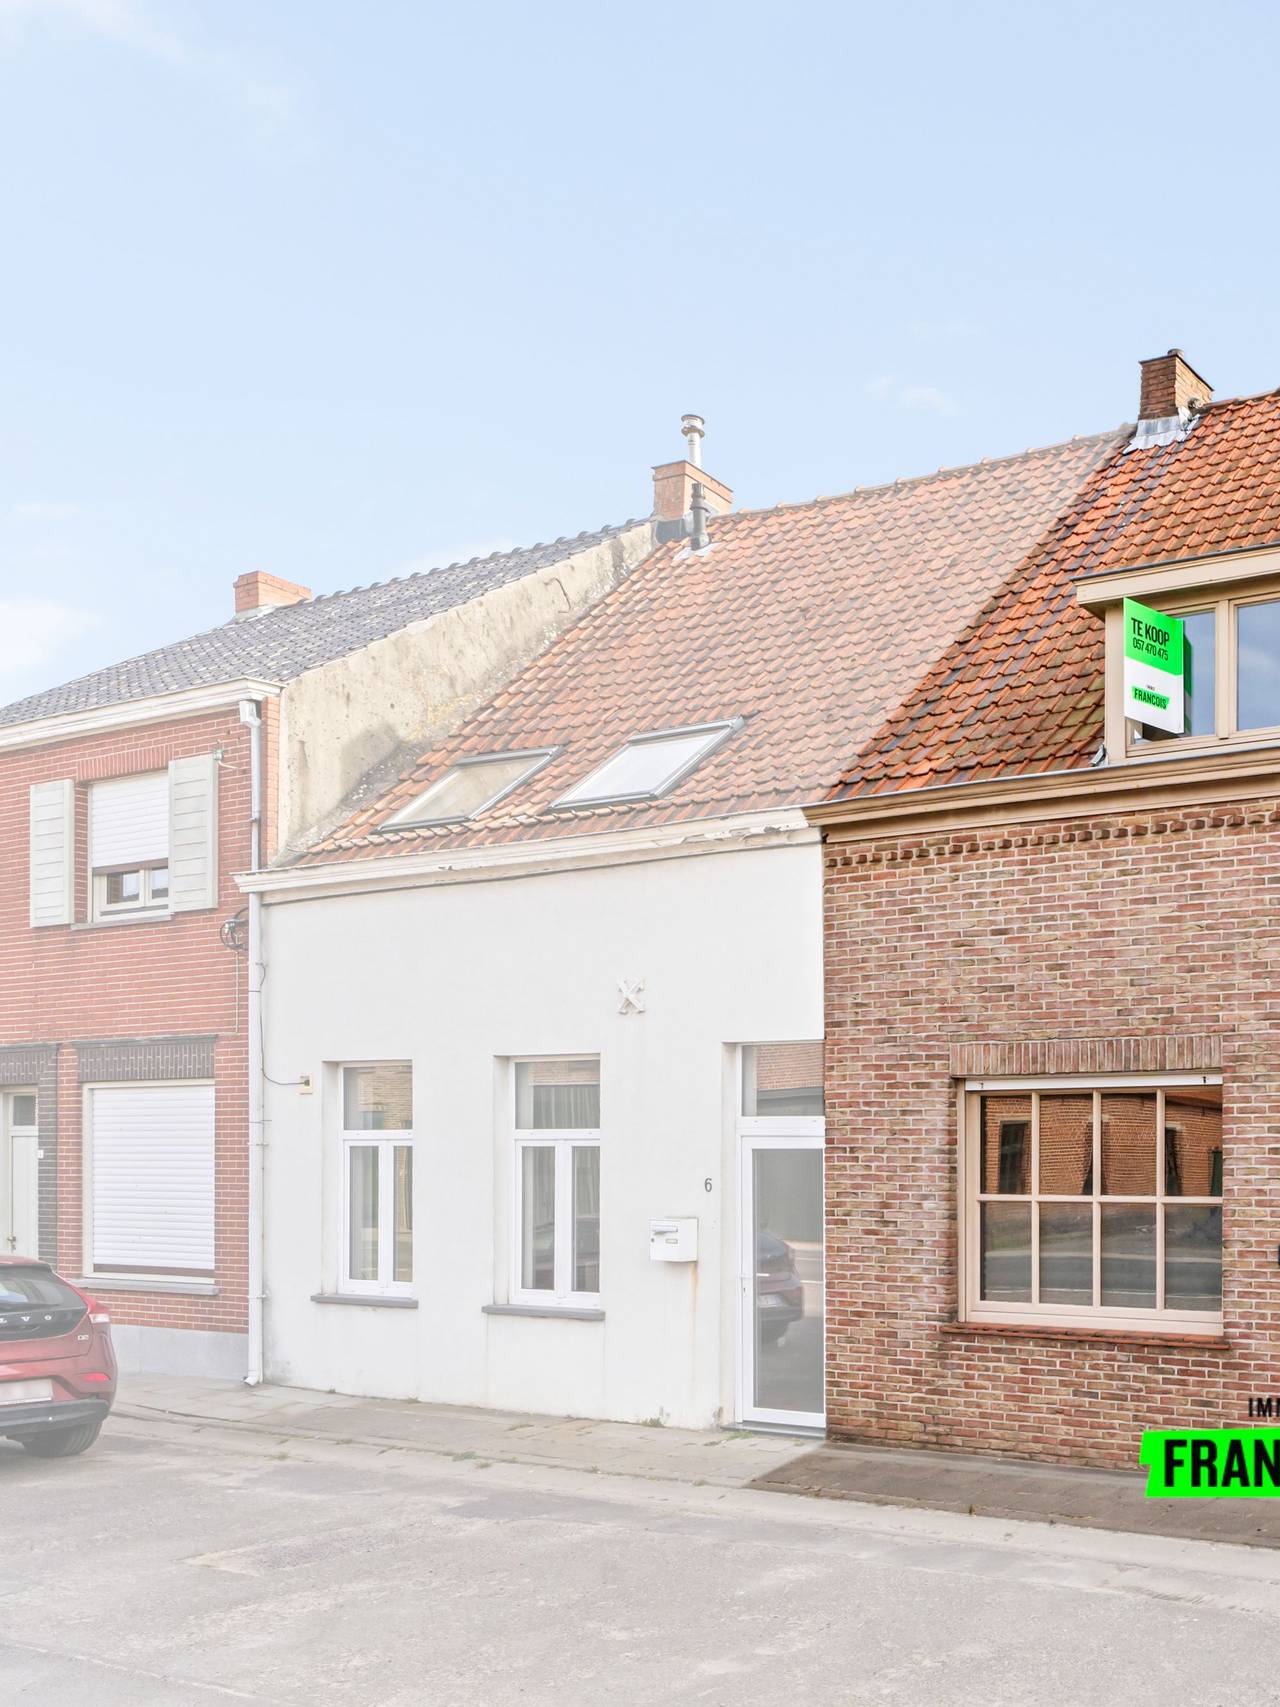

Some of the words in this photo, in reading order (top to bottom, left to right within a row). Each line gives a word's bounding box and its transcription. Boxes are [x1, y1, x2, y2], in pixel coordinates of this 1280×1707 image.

[1131, 617, 1143, 637] TE
[1145, 623, 1170, 647] KOOP
[1133, 637, 1145, 651] 057
[1145, 642, 1156, 656] 470
[1157, 647, 1169, 661] 475
[1134, 687, 1167, 710] FRANCOIS
[704, 1178, 713, 1192] 6
